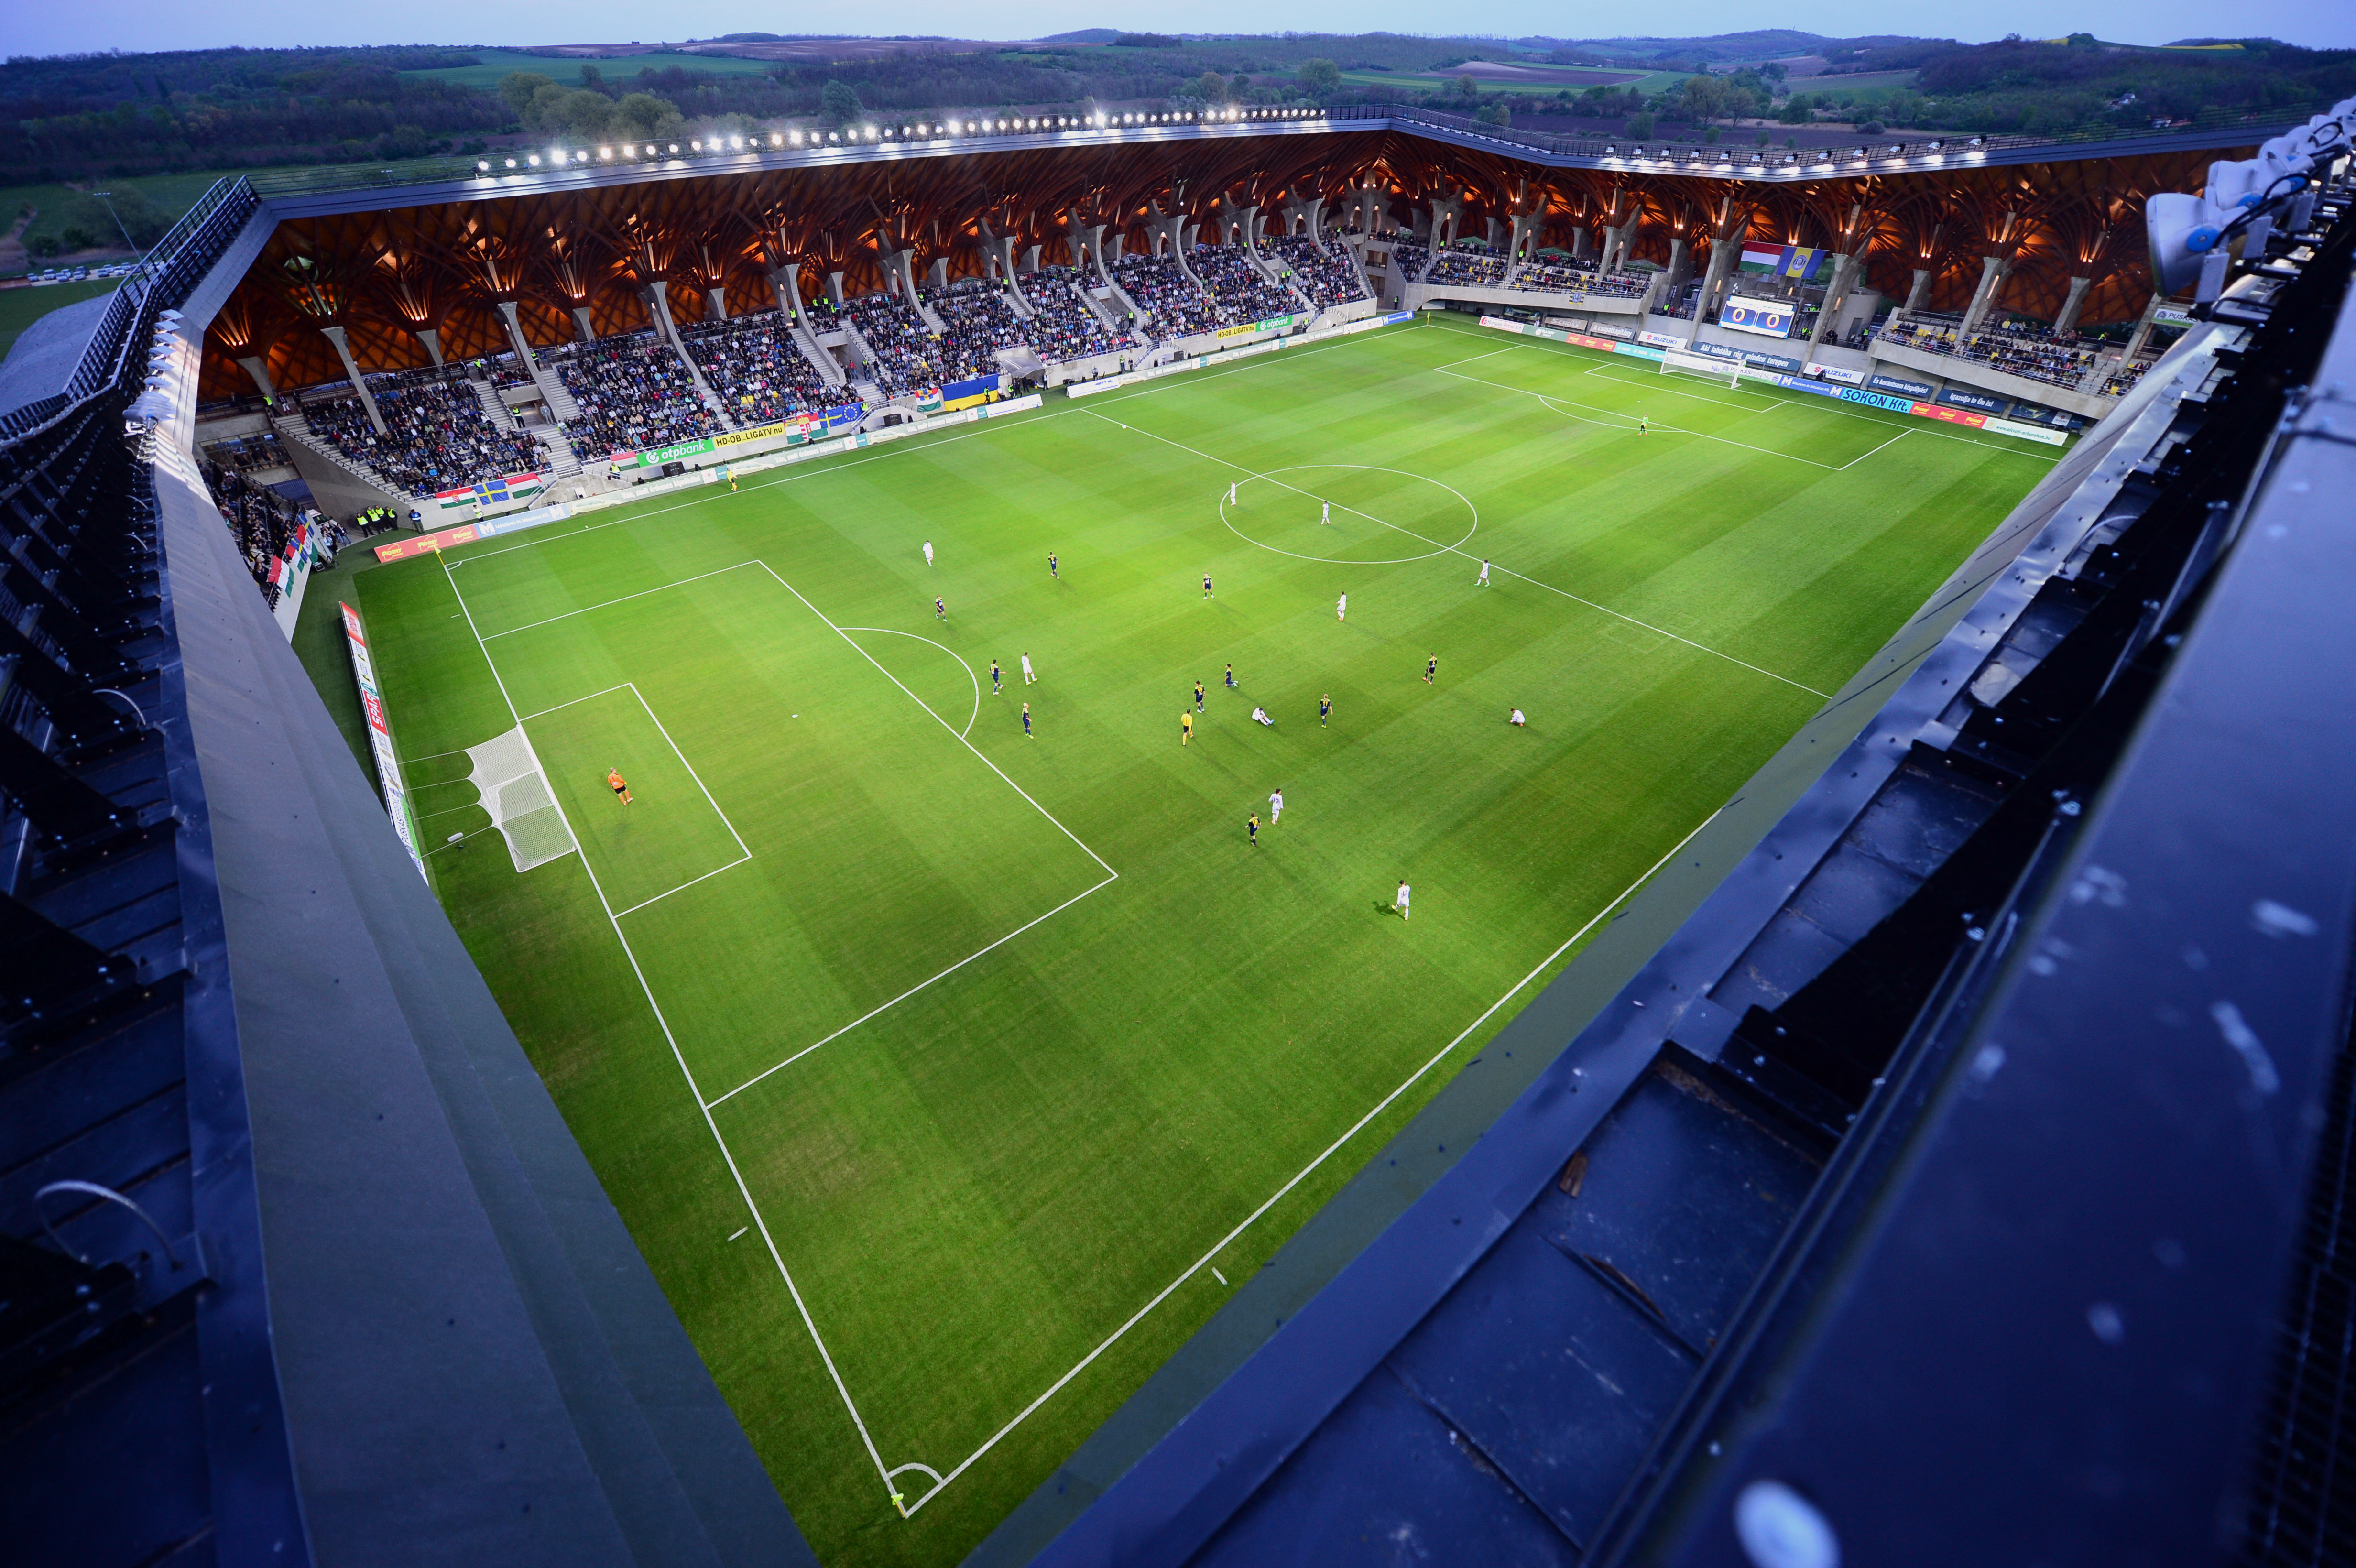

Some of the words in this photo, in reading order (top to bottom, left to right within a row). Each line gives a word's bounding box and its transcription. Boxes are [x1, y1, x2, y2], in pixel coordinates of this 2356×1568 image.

[1267, 317, 1289, 329] otpbank
[1732, 308, 1745, 323] 0
[1766, 314, 1780, 328] 0
[1598, 326, 1632, 338] csapatkapitány
[1653, 336, 1678, 345] SUZUKI
[1700, 343, 1711, 351] Aki
[1711, 346, 1732, 356] labdába
[1733, 350, 1744, 359] rúg
[1745, 353, 1766, 362] minden
[1767, 357, 1789, 367] terepen
[1730, 366, 1772, 379] PUKÁSFERENC
[1823, 369, 1853, 378] SUZUKI
[1880, 379, 1903, 389] korántsem
[1904, 384, 1929, 394] kispályás!
[1843, 390, 1887, 406] SOKON
[1888, 399, 1908, 412] Kft.
[1950, 393, 1971, 403] Igazolja
[661, 441, 705, 460] otpbank
[453, 531, 472, 539] PENNY
[417, 539, 437, 548] PENNY
[382, 548, 402, 556] PENNY
[366, 693, 383, 728] SPAR
